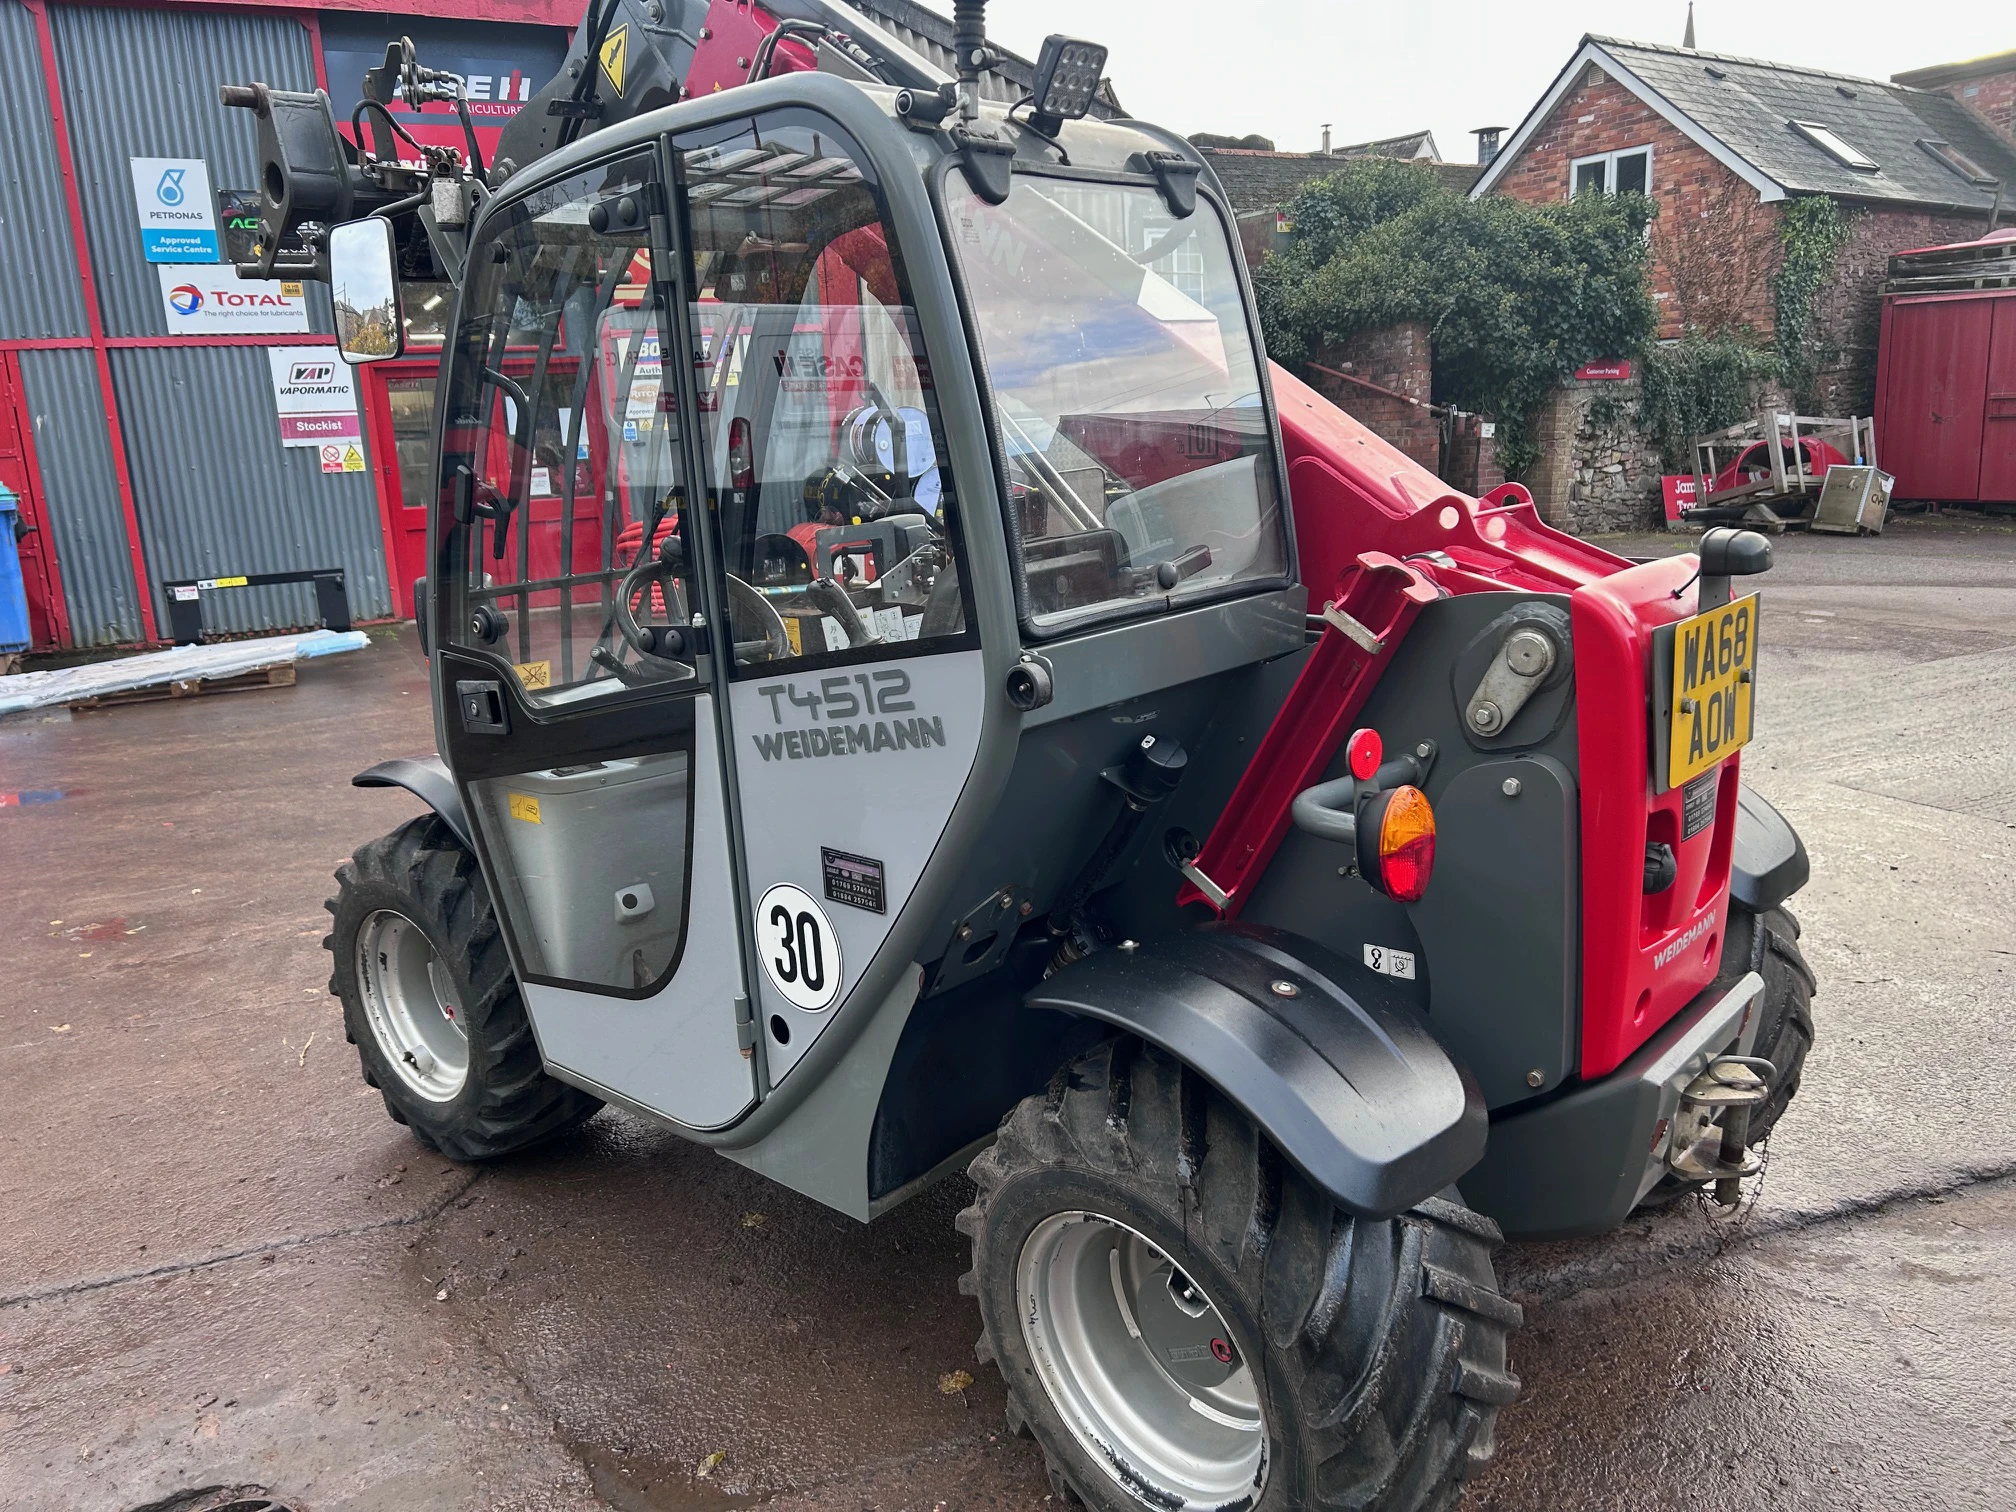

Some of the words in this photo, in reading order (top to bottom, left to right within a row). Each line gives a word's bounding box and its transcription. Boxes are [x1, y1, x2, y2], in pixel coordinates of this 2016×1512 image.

[449, 103, 523, 115] ARICULTURE
[150, 211, 203, 220] PETRONAS
[160, 236, 201, 246] Approved
[151, 245, 182, 253] Service
[183, 245, 213, 253] Centre
[210, 290, 292, 307] TOTAL
[217, 310, 234, 318] right
[295, 367, 331, 380] VAP
[1605, 368, 1620, 376] Parking
[280, 385, 349, 395] VAPORMATIC
[296, 420, 342, 431] Stockist
[1675, 480, 1707, 494] Jams
[1683, 606, 1749, 692] WA68
[758, 668, 916, 725] T4512
[1688, 681, 1737, 765] AOW
[751, 715, 946, 762] WEIDEMANN
[1654, 908, 1716, 971] WEIDEMANN
[771, 904, 824, 991] 30
